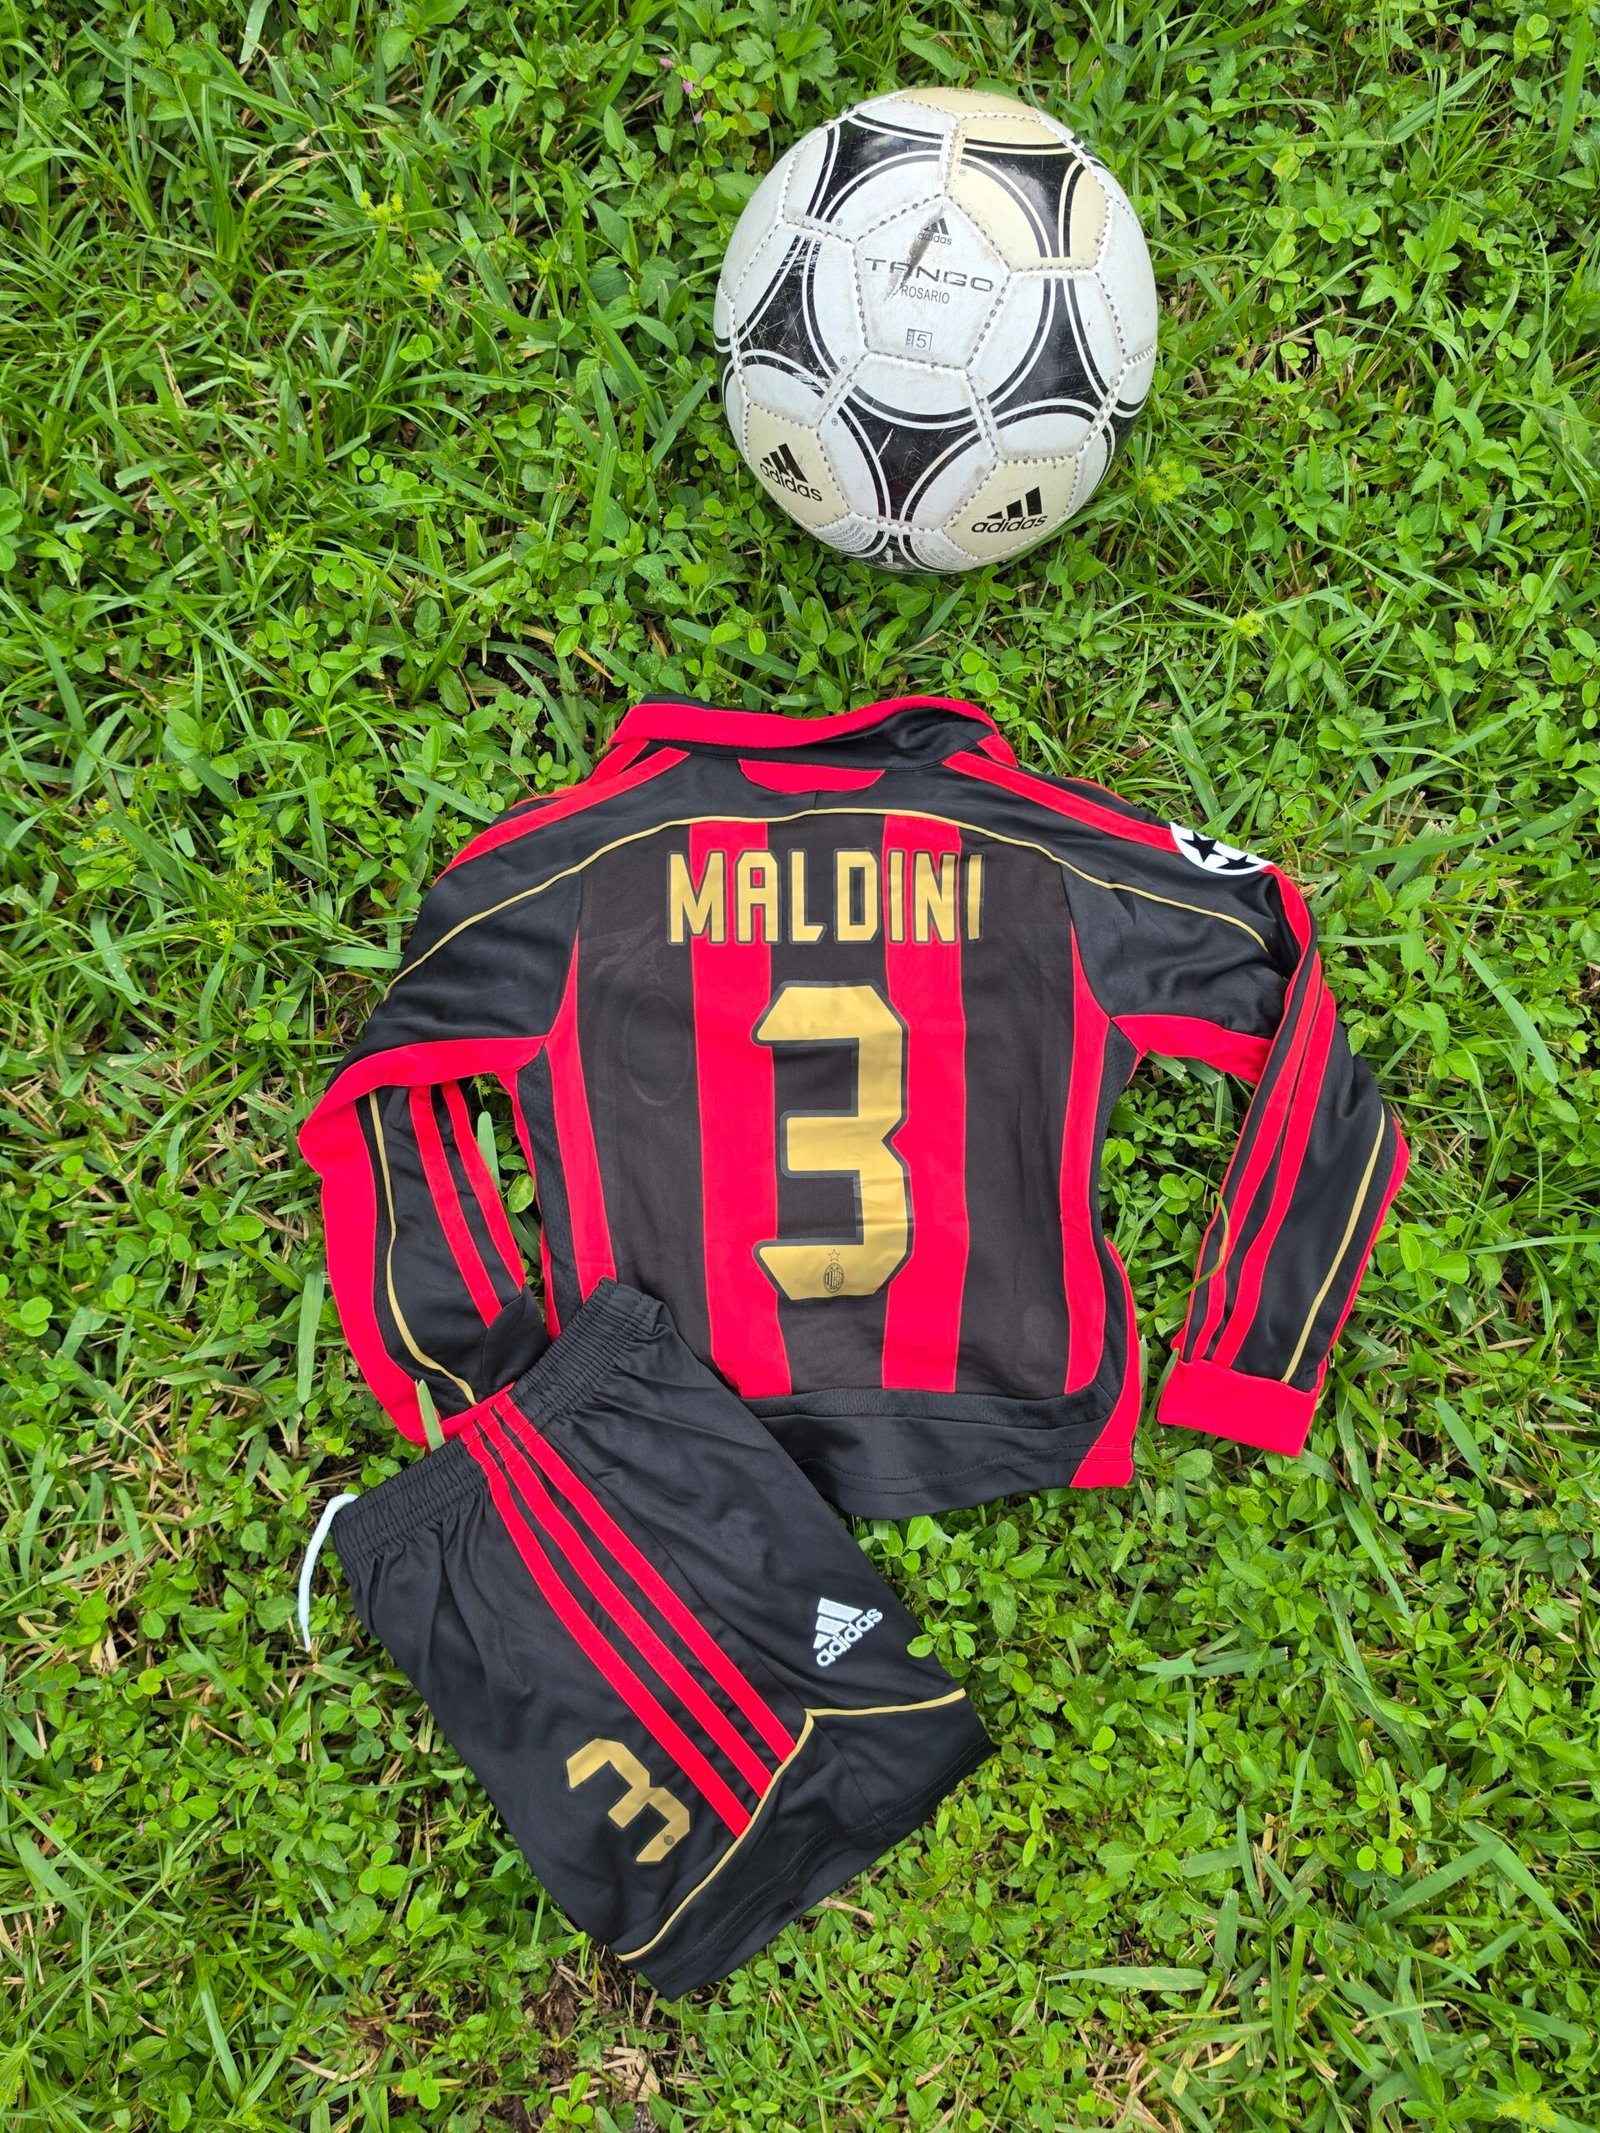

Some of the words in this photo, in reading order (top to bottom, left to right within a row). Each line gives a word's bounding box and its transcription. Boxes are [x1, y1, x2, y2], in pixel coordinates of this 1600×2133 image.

[917, 231, 953, 246] adidas
[864, 257, 995, 293] TANGO
[901, 285, 950, 305] ROSARIO
[759, 462, 823, 502] adidas
[971, 515, 1048, 533] adidas
[668, 849, 985, 944] MALDINI
[753, 983, 912, 1302] 3
[816, 1608, 884, 1667] adidas
[565, 1737, 691, 1864] 3
